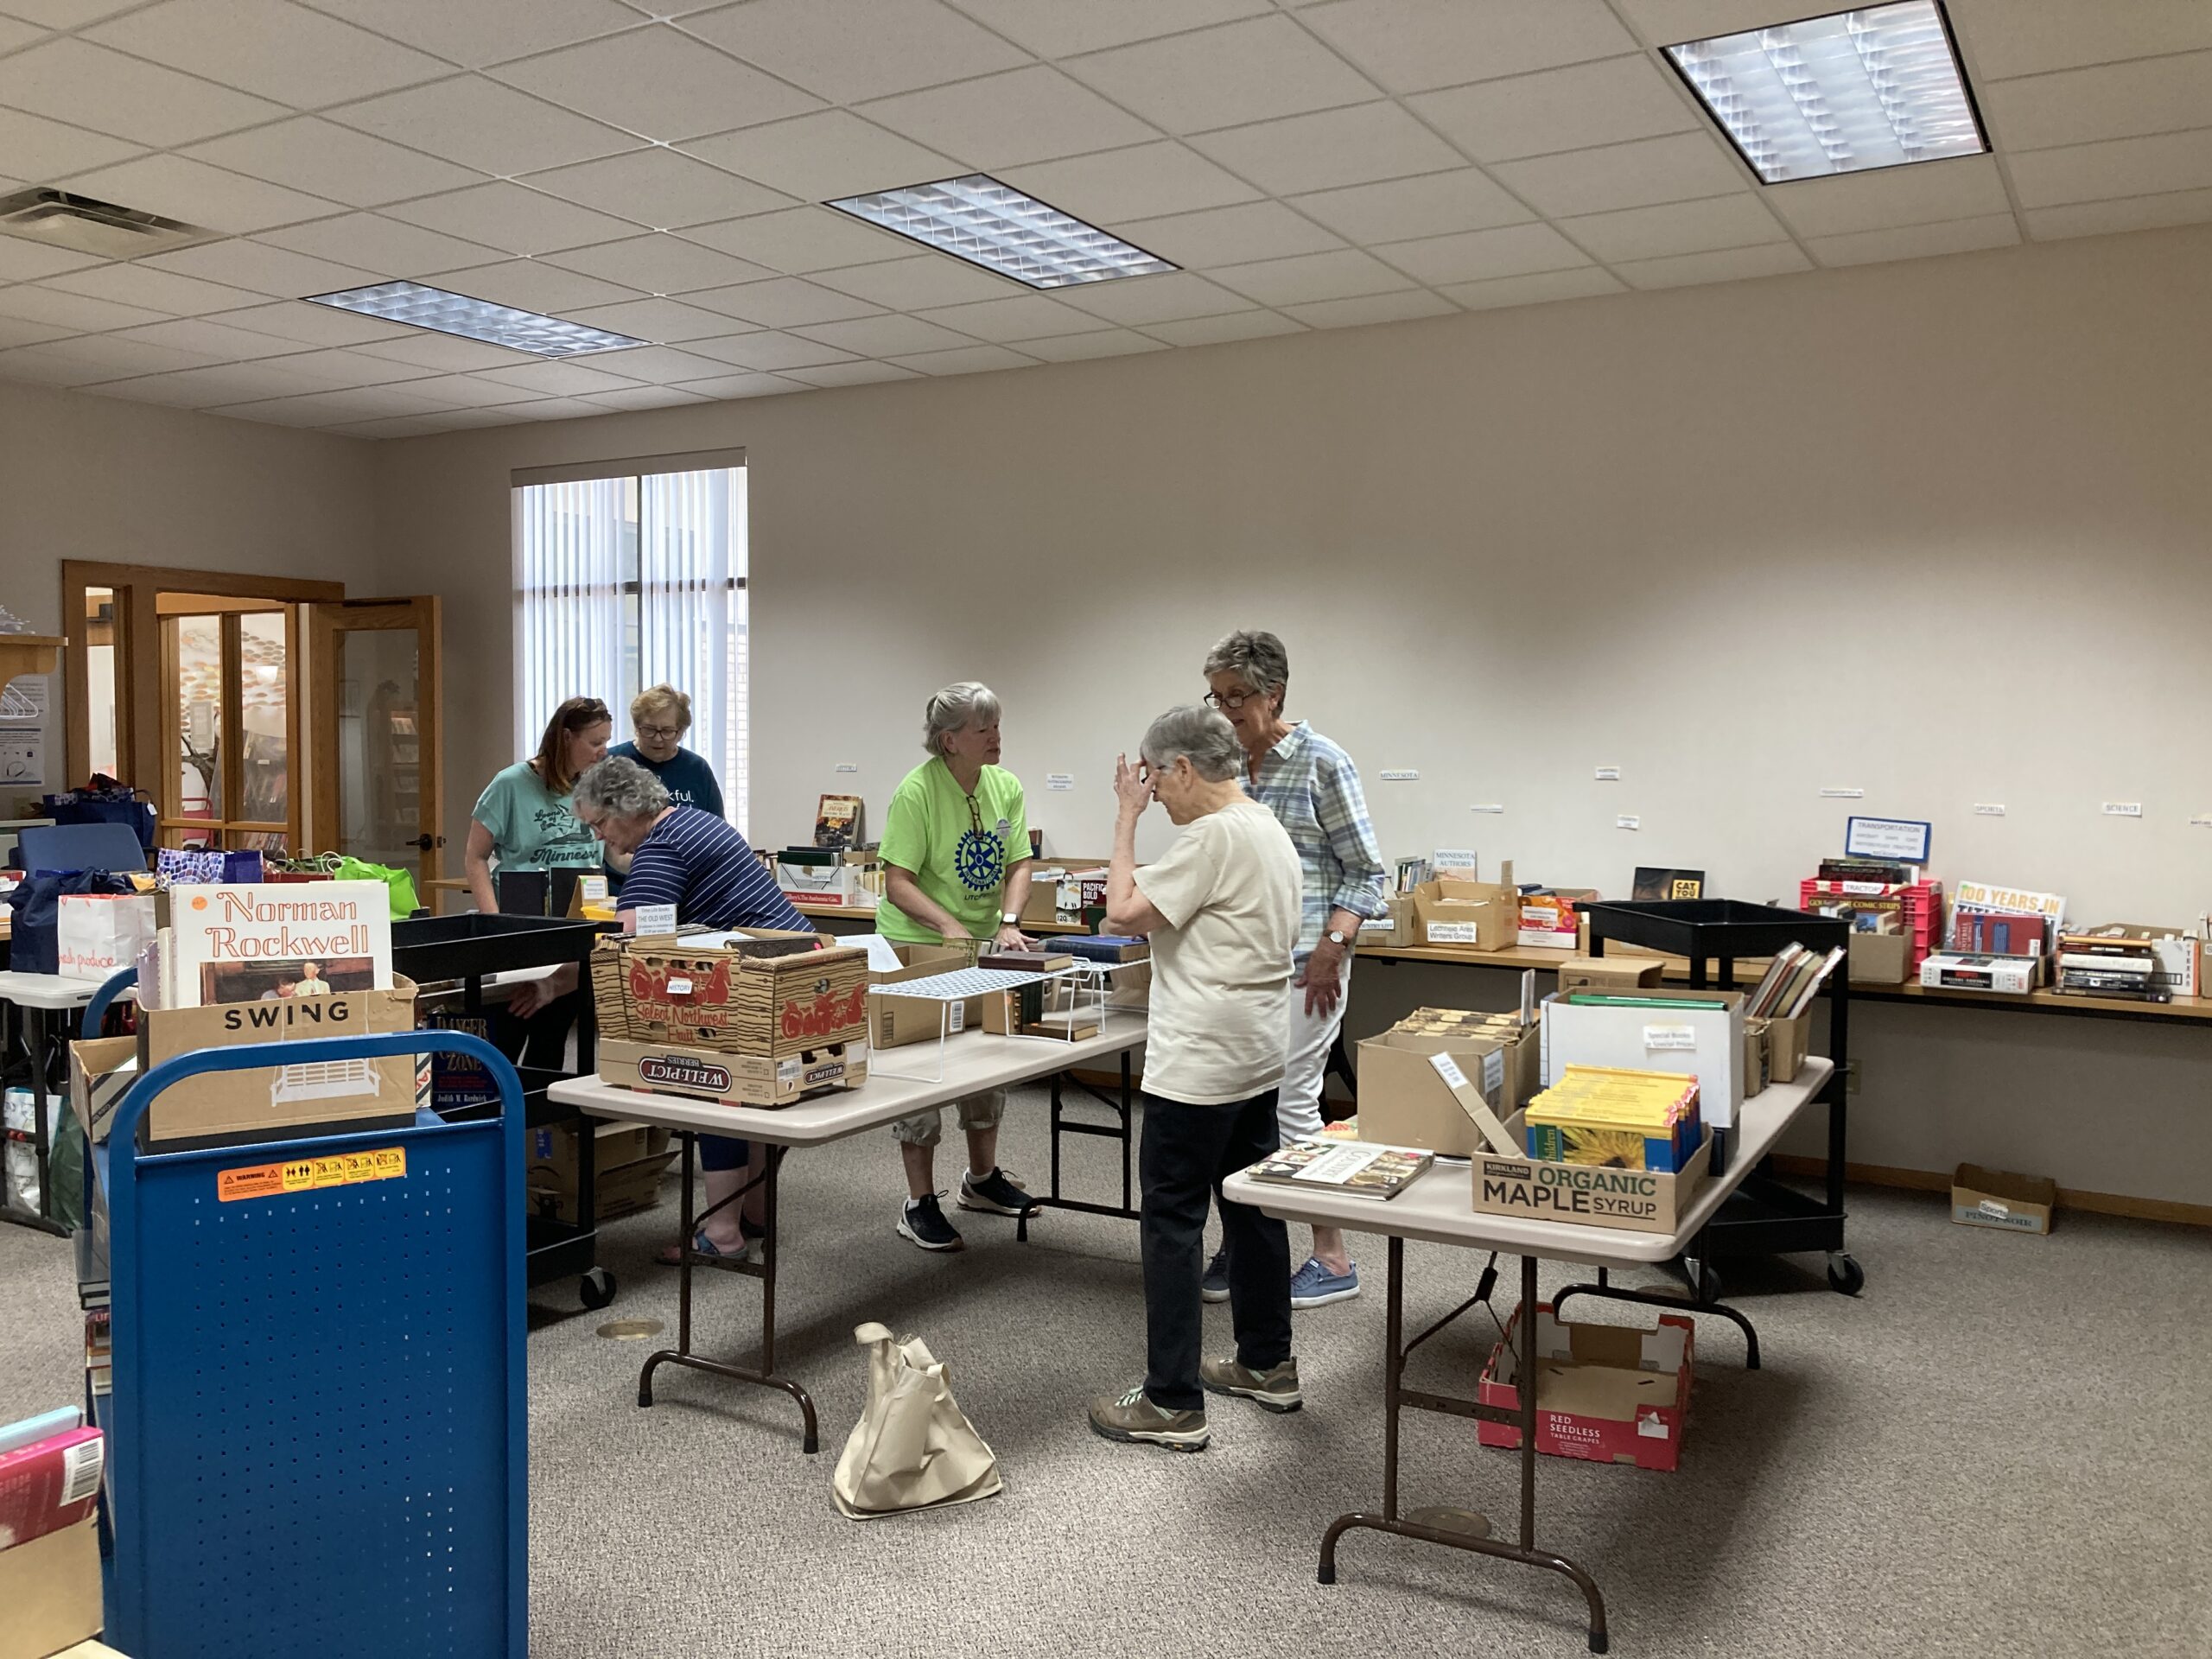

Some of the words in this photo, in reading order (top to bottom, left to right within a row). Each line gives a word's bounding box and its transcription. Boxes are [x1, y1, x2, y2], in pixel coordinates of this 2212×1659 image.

[2106, 804, 2139, 812] SCIENCE
[1858, 822, 1921, 833] TRANSPORTATION
[1083, 882, 1103, 892] PACIFIC
[1083, 891, 1097, 899] BOLD
[217, 892, 357, 922] Norman
[1960, 886, 1986, 903] 100
[1991, 889, 2039, 912] YEARS
[2043, 897, 2060, 914] IN
[205, 925, 368, 957] Rockwell
[77, 949, 114, 974] produce
[225, 1001, 348, 1030] SWING
[636, 1002, 671, 1020] Select
[673, 1007, 728, 1026] Northwest
[667, 1025, 696, 1043] Fruit
[447, 1053, 483, 1071] ZONE
[667, 1056, 699, 1067] BERRIES
[437, 1094, 454, 1103] Judith
[1544, 1128, 1558, 1161] hildren
[236, 1172, 265, 1181] WARNING
[1485, 1162, 1529, 1175] KIRKLAND
[1538, 1166, 1656, 1197] ORGANIC
[1484, 1179, 1591, 1213] MAPLE
[1593, 1197, 1656, 1216] SYRUP
[1981, 1202, 2005, 1217] Sports
[1550, 1414, 1572, 1425] RED
[1550, 1424, 1600, 1439] SEEDLESS
[1550, 1432, 1571, 1441] TABLE
[1573, 1434, 1600, 1445] GRAPES
